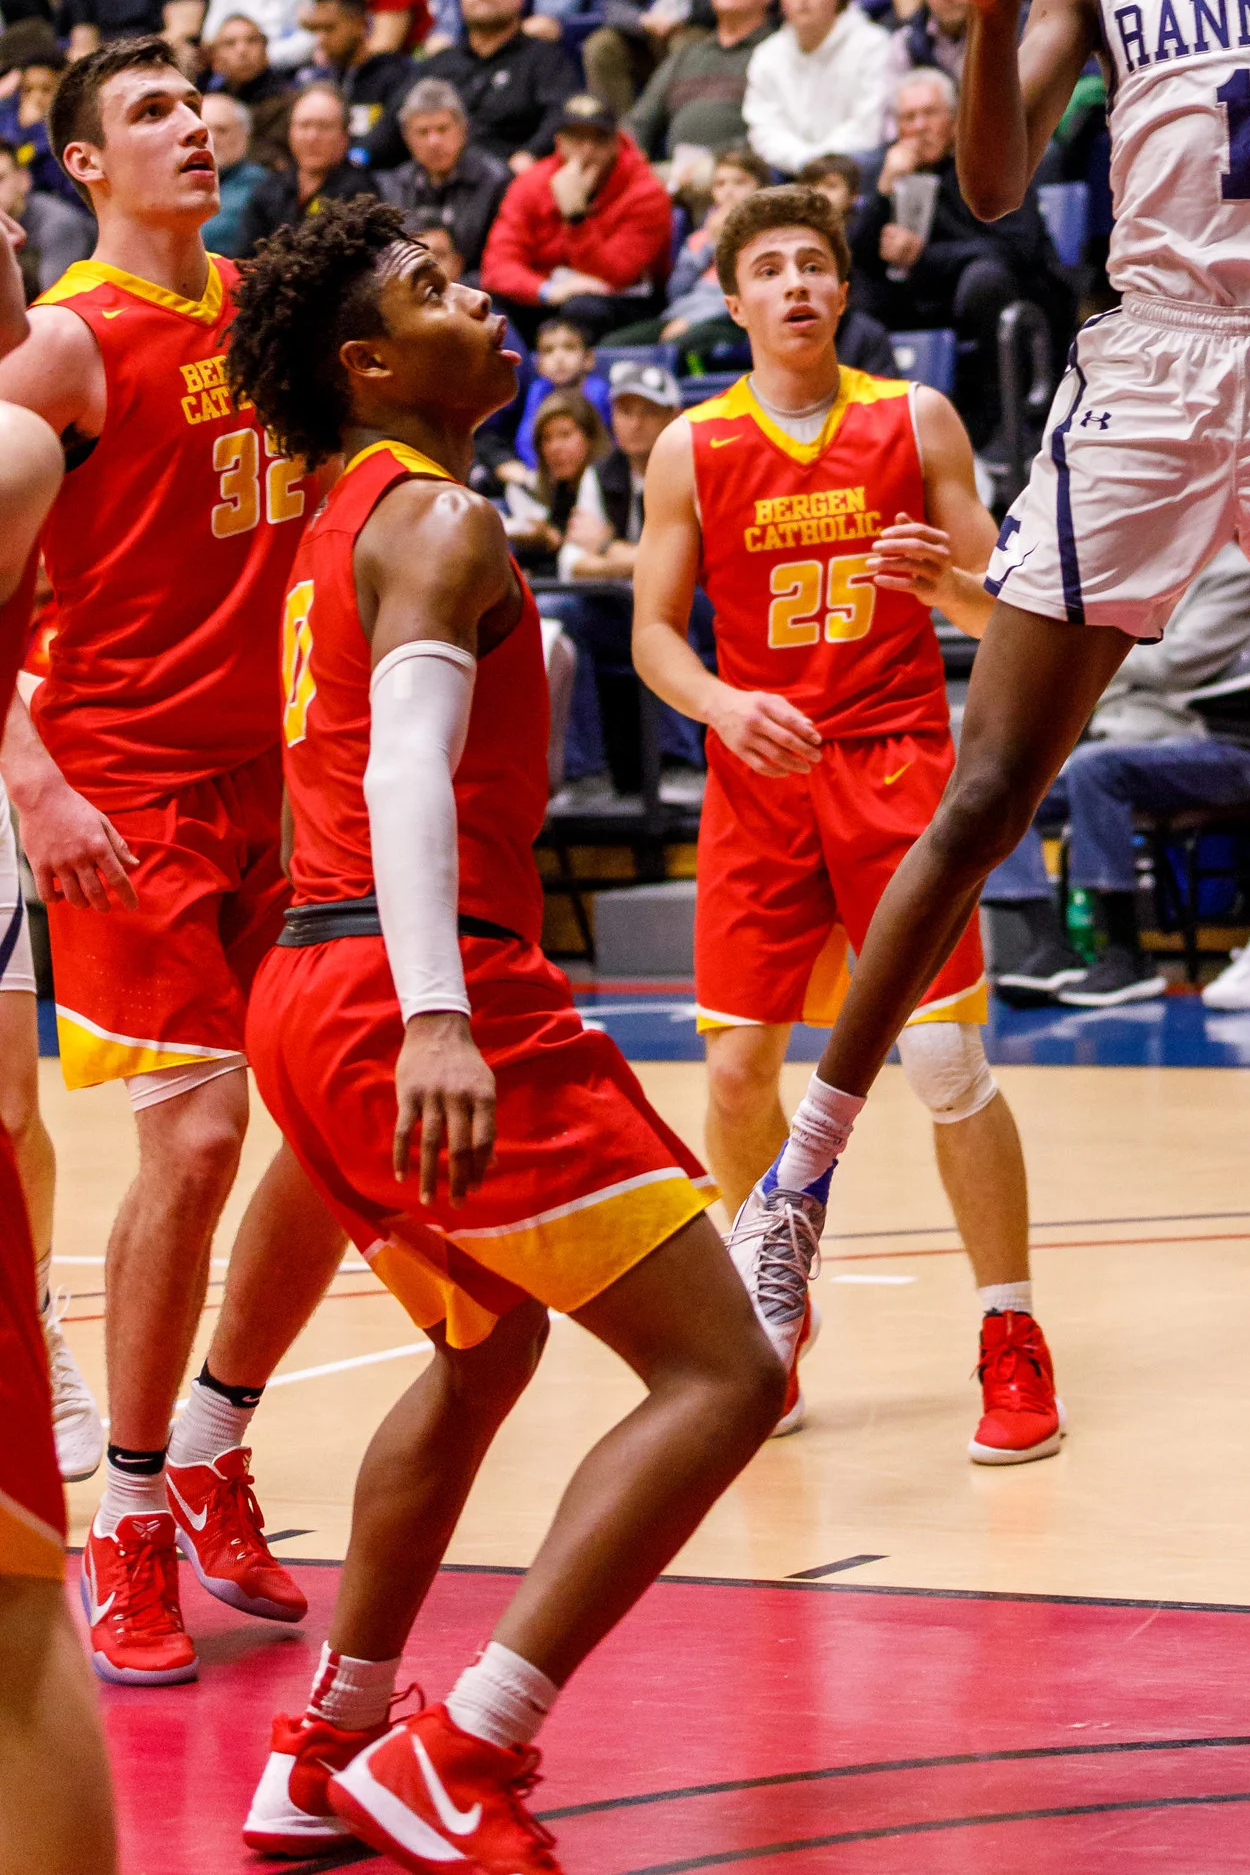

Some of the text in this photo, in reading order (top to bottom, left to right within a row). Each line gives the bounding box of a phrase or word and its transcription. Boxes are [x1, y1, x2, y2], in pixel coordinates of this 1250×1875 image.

[211, 425, 305, 540] 32
[755, 486, 867, 525] BERGEN
[744, 511, 883, 553] CATHOLIC
[767, 553, 880, 649] 25
